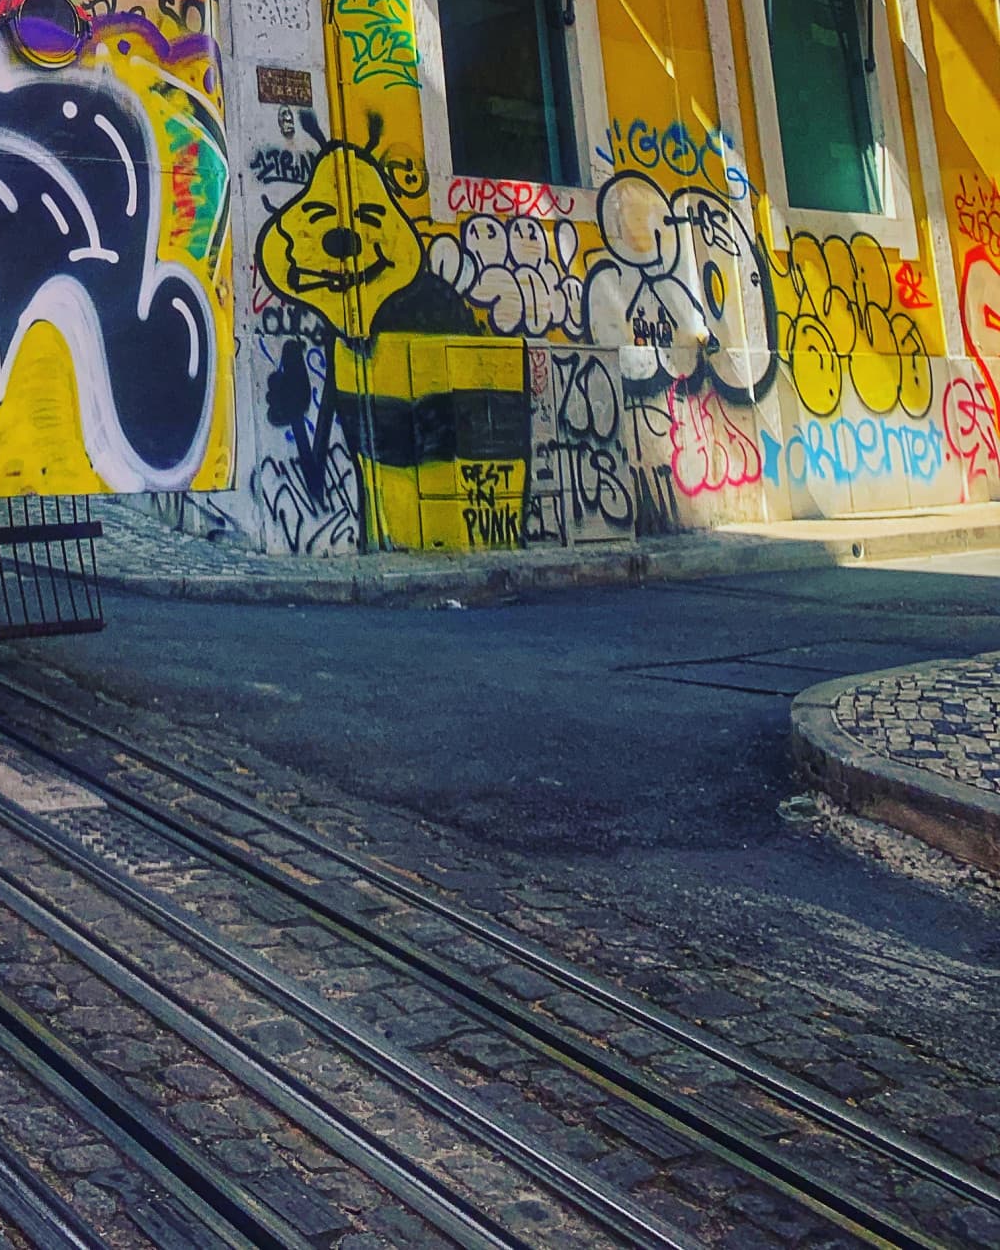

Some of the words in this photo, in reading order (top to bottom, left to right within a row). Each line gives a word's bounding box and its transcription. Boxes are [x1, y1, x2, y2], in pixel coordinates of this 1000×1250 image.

[461, 462, 514, 490] REST
[467, 486, 496, 508] IN
[462, 502, 520, 547] PUNK
